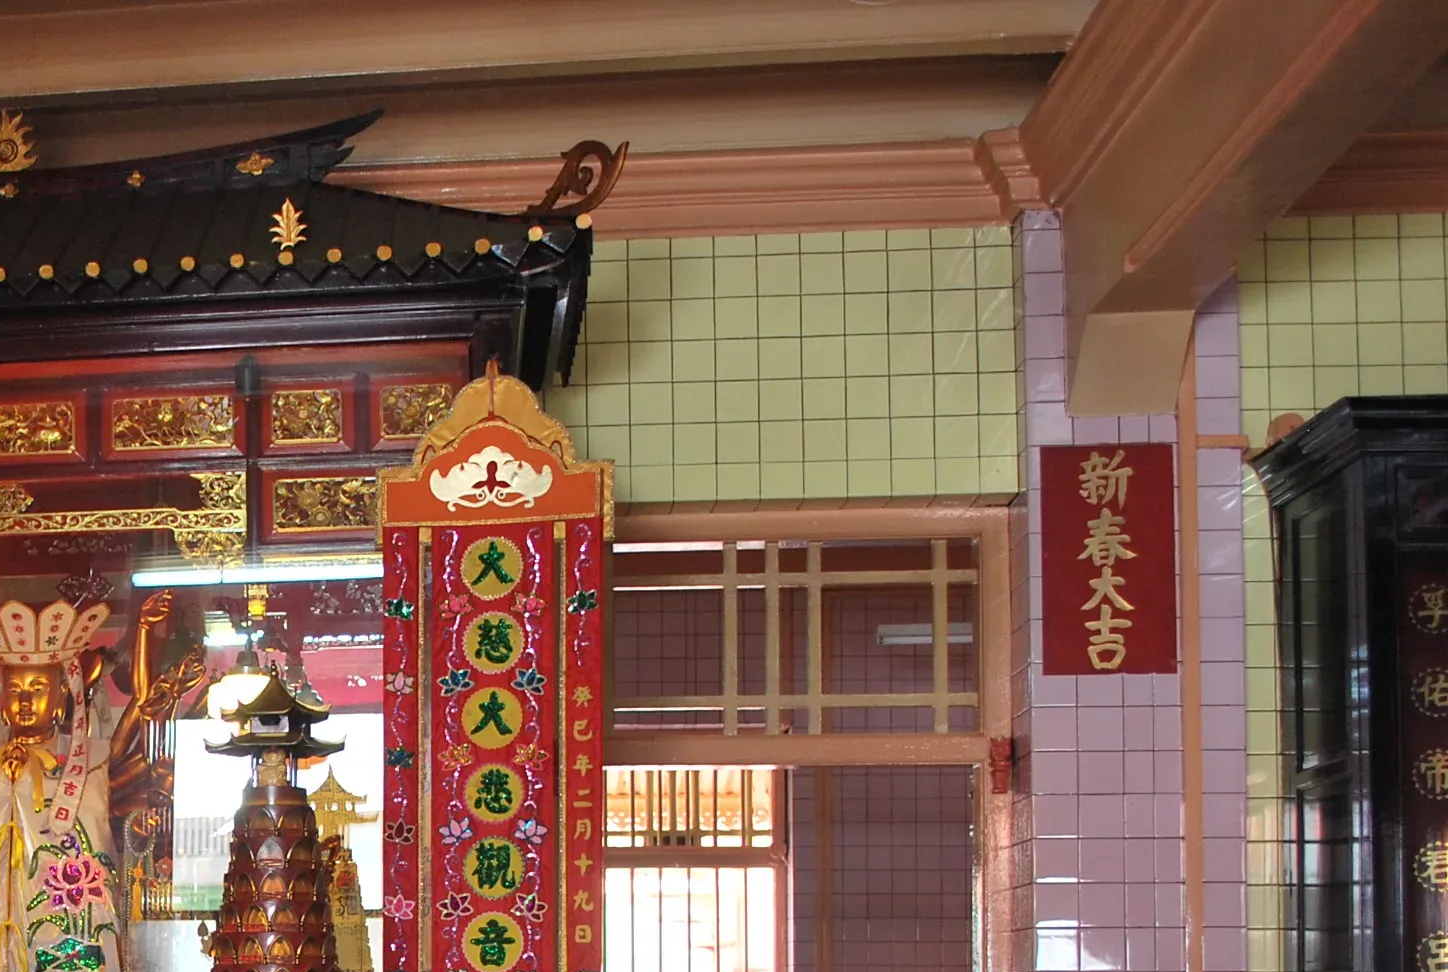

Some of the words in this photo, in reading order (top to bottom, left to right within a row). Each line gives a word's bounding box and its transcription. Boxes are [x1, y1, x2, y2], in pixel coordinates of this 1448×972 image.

[1076, 449, 1139, 670] 新春大吉
[571, 685, 594, 944] 癸巳年二月十九日
